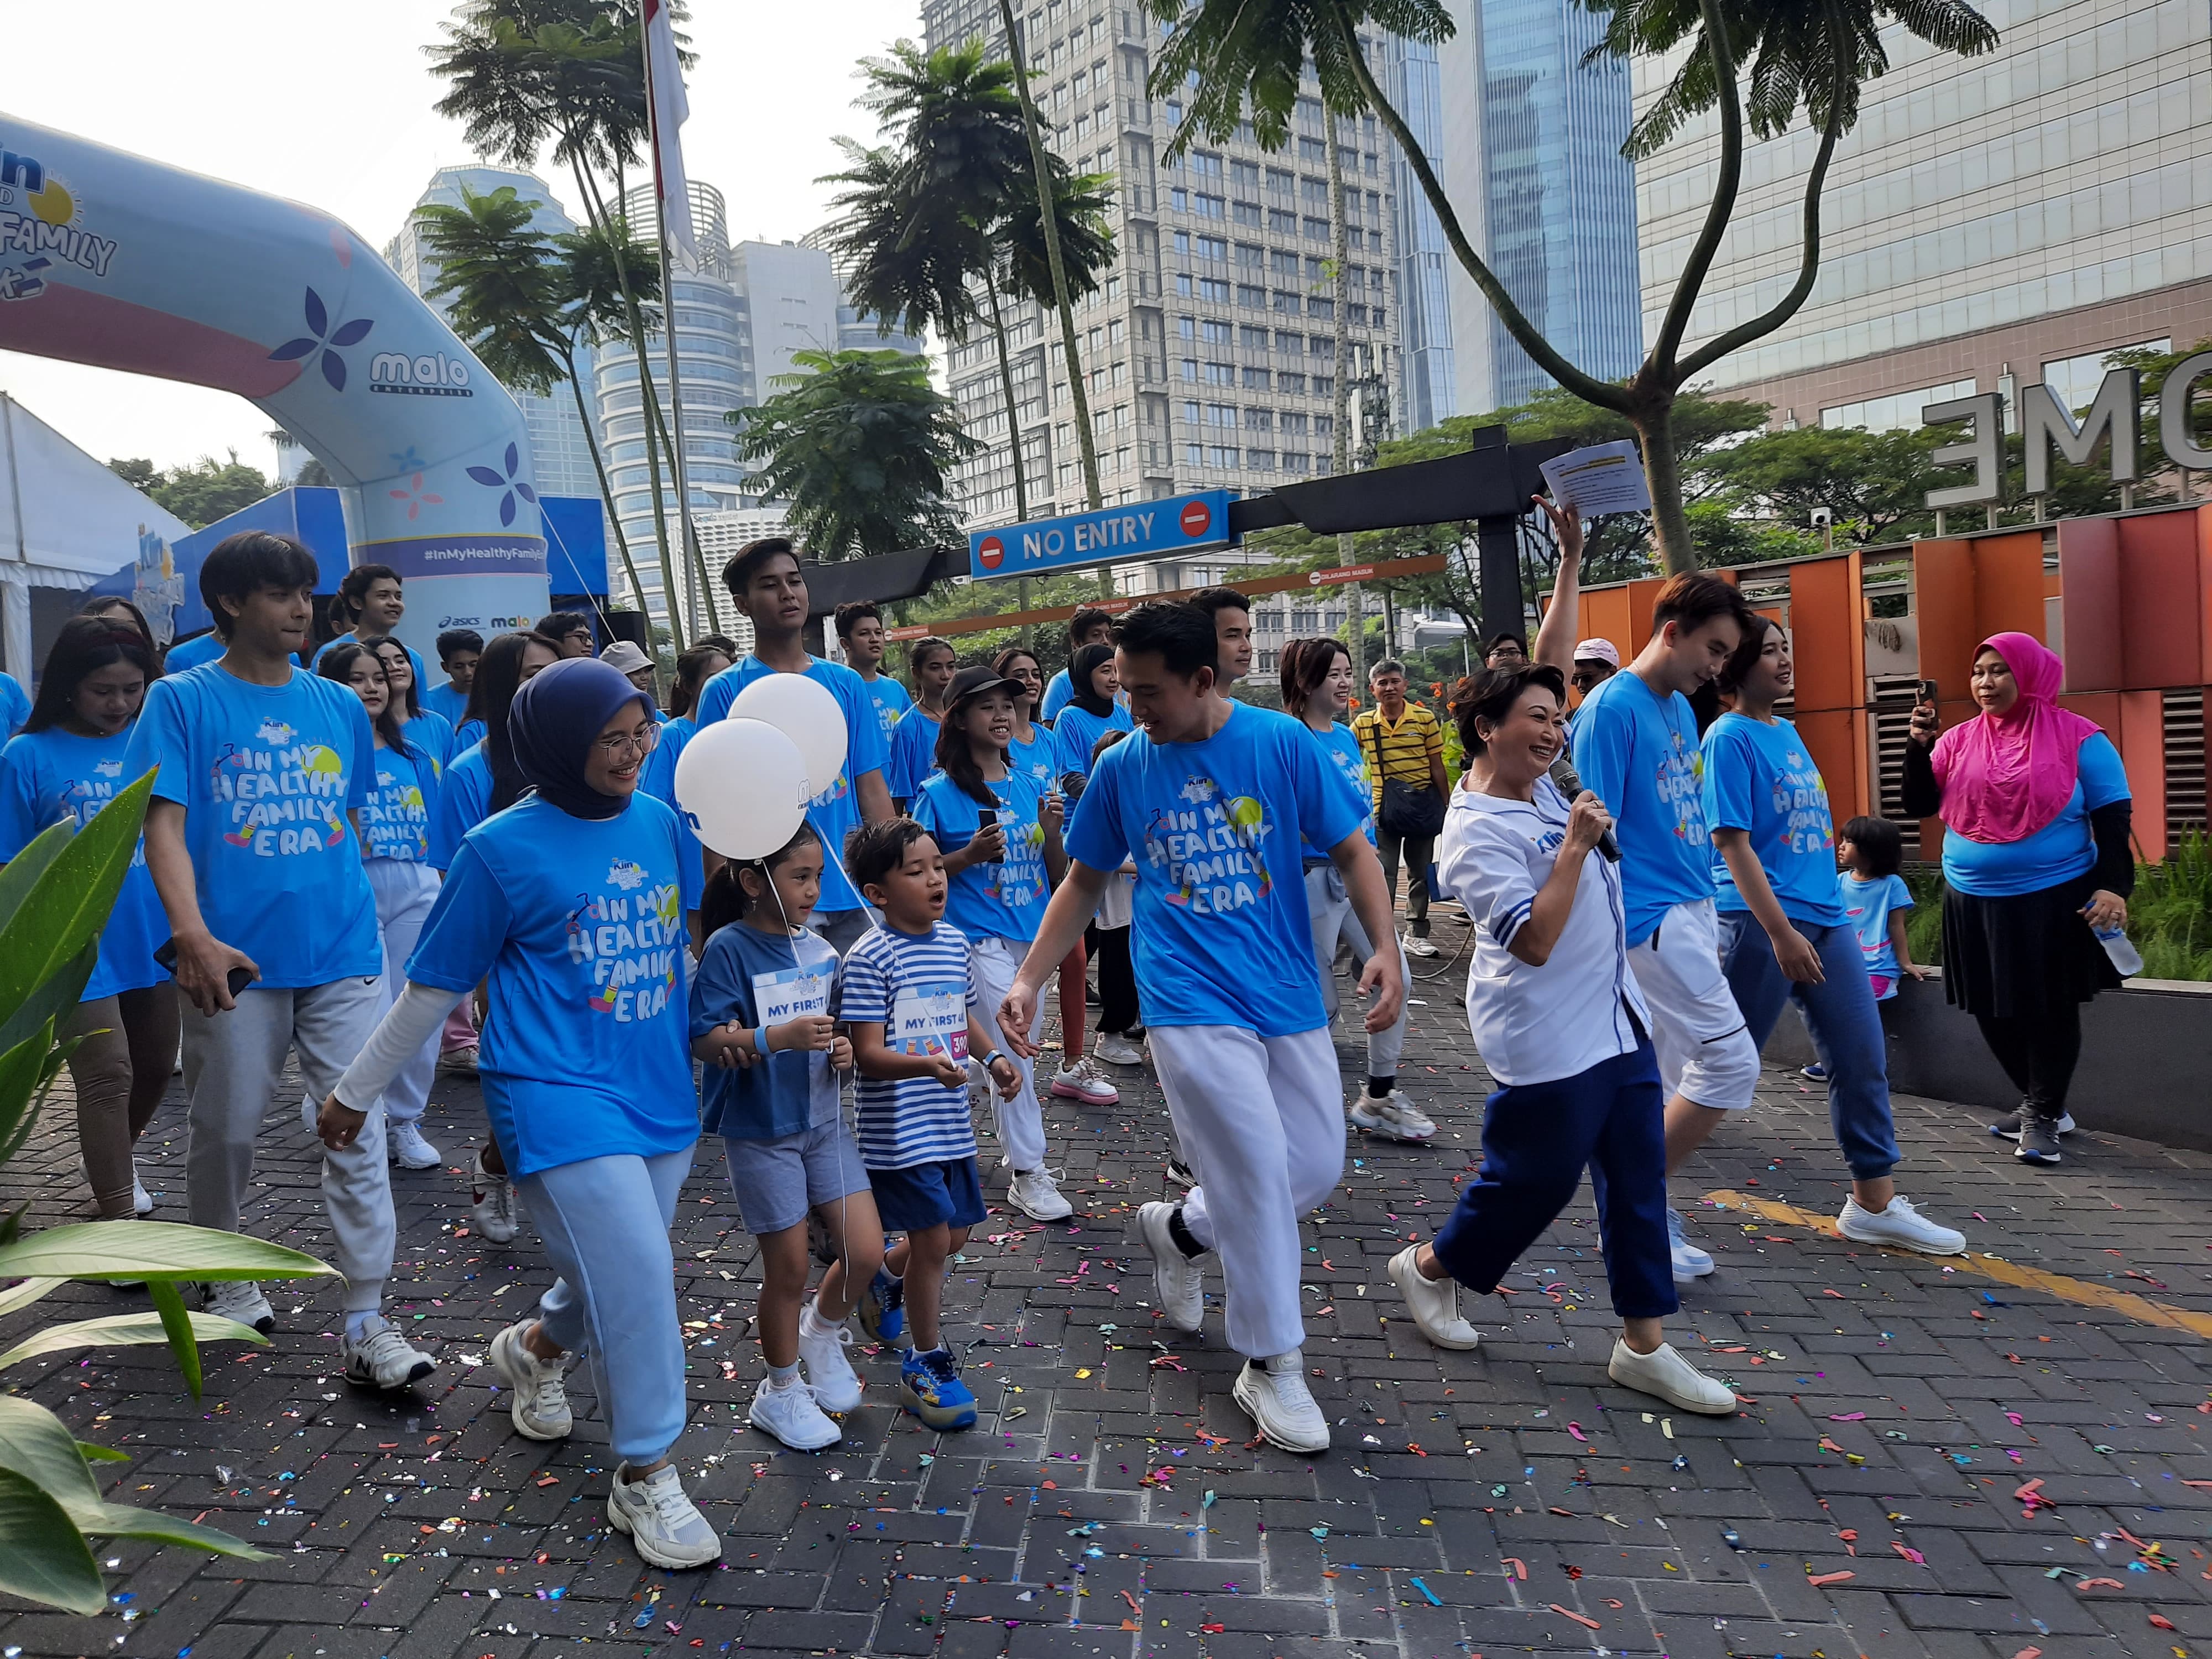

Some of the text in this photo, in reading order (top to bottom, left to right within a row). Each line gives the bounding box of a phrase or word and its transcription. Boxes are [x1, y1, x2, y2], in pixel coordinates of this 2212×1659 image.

[370, 351, 469, 387] malo
[1024, 512, 1155, 560] NO ENTRY
[491, 615, 531, 628] malo
[242, 743, 322, 771] IN MY
[82, 780, 112, 798] IN
[212, 769, 348, 802] HEALTHY
[384, 785, 414, 804] MY
[1188, 777, 1207, 786] Klin
[232, 797, 337, 827] FAMILY
[1167, 798, 1244, 831] IN MY
[254, 827, 323, 857] ERA
[1011, 822, 1037, 842] MY
[1146, 821, 1274, 869] HEALTHY
[1536, 831, 1565, 854] Klin
[988, 863, 1042, 885] FAMILY
[1170, 851, 1263, 885] FAMILY
[597, 884, 675, 922] IN MY
[1001, 885, 1033, 907] ERA
[1193, 881, 1255, 914] ERA
[615, 984, 667, 1022] ERA
[768, 1003, 789, 1018] MY
[905, 1018, 926, 1030] MY
